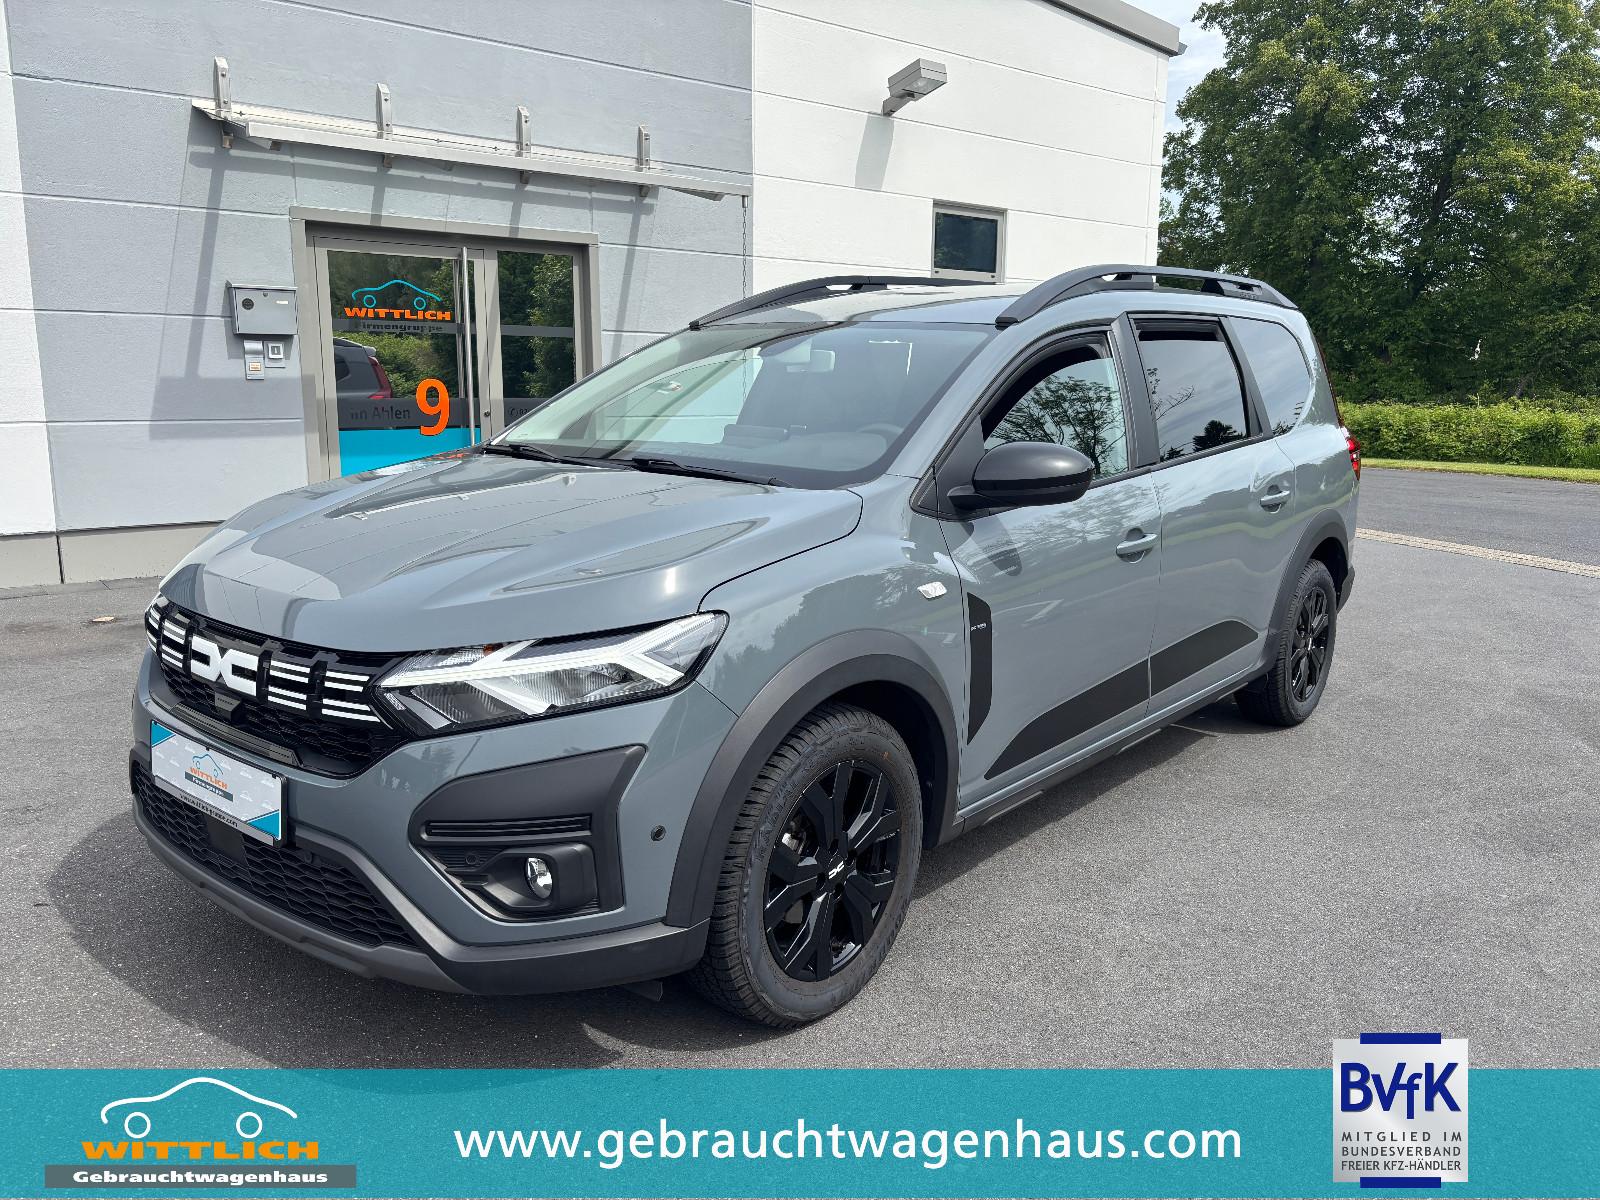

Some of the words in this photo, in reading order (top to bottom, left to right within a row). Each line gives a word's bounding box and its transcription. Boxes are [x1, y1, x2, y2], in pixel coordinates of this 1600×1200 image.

[344, 307, 451, 320] WITTLICH
[372, 405, 411, 420] Ahlen
[415, 378, 450, 435] 9
[189, 766, 229, 790] WITTLICH
